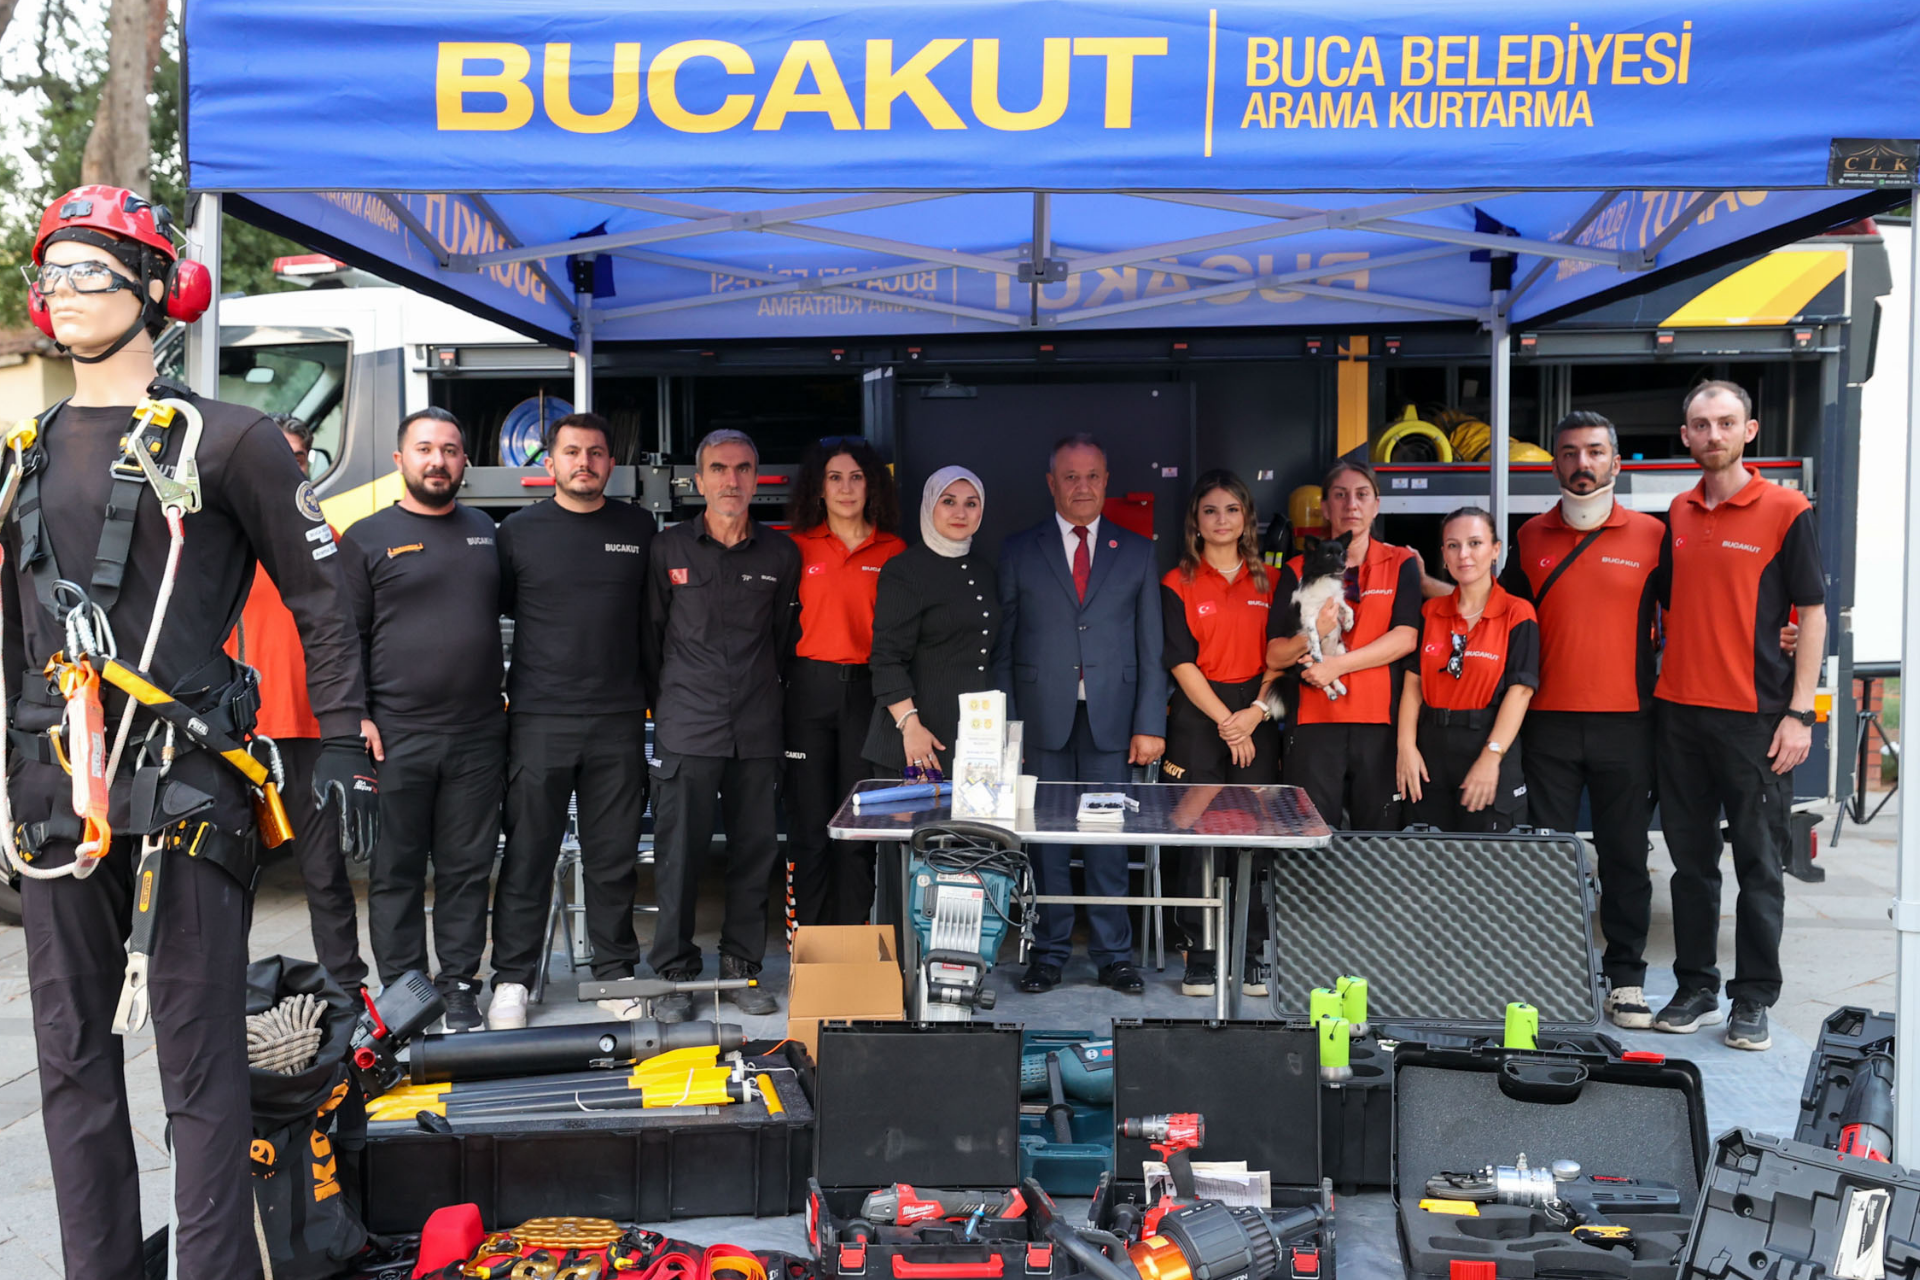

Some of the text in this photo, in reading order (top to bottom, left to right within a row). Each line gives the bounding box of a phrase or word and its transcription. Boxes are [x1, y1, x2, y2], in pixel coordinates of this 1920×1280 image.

[1246, 20, 1692, 87] BUCA BELEDİYESİ
[436, 37, 1168, 134] BUCAKUT
[1240, 91, 1594, 129] ARAMA KURTARMA
[605, 543, 640, 554] BUCAKUT
[1722, 540, 1761, 553] BUCAKUT
[902, 1204, 935, 1215] Milwaukee
